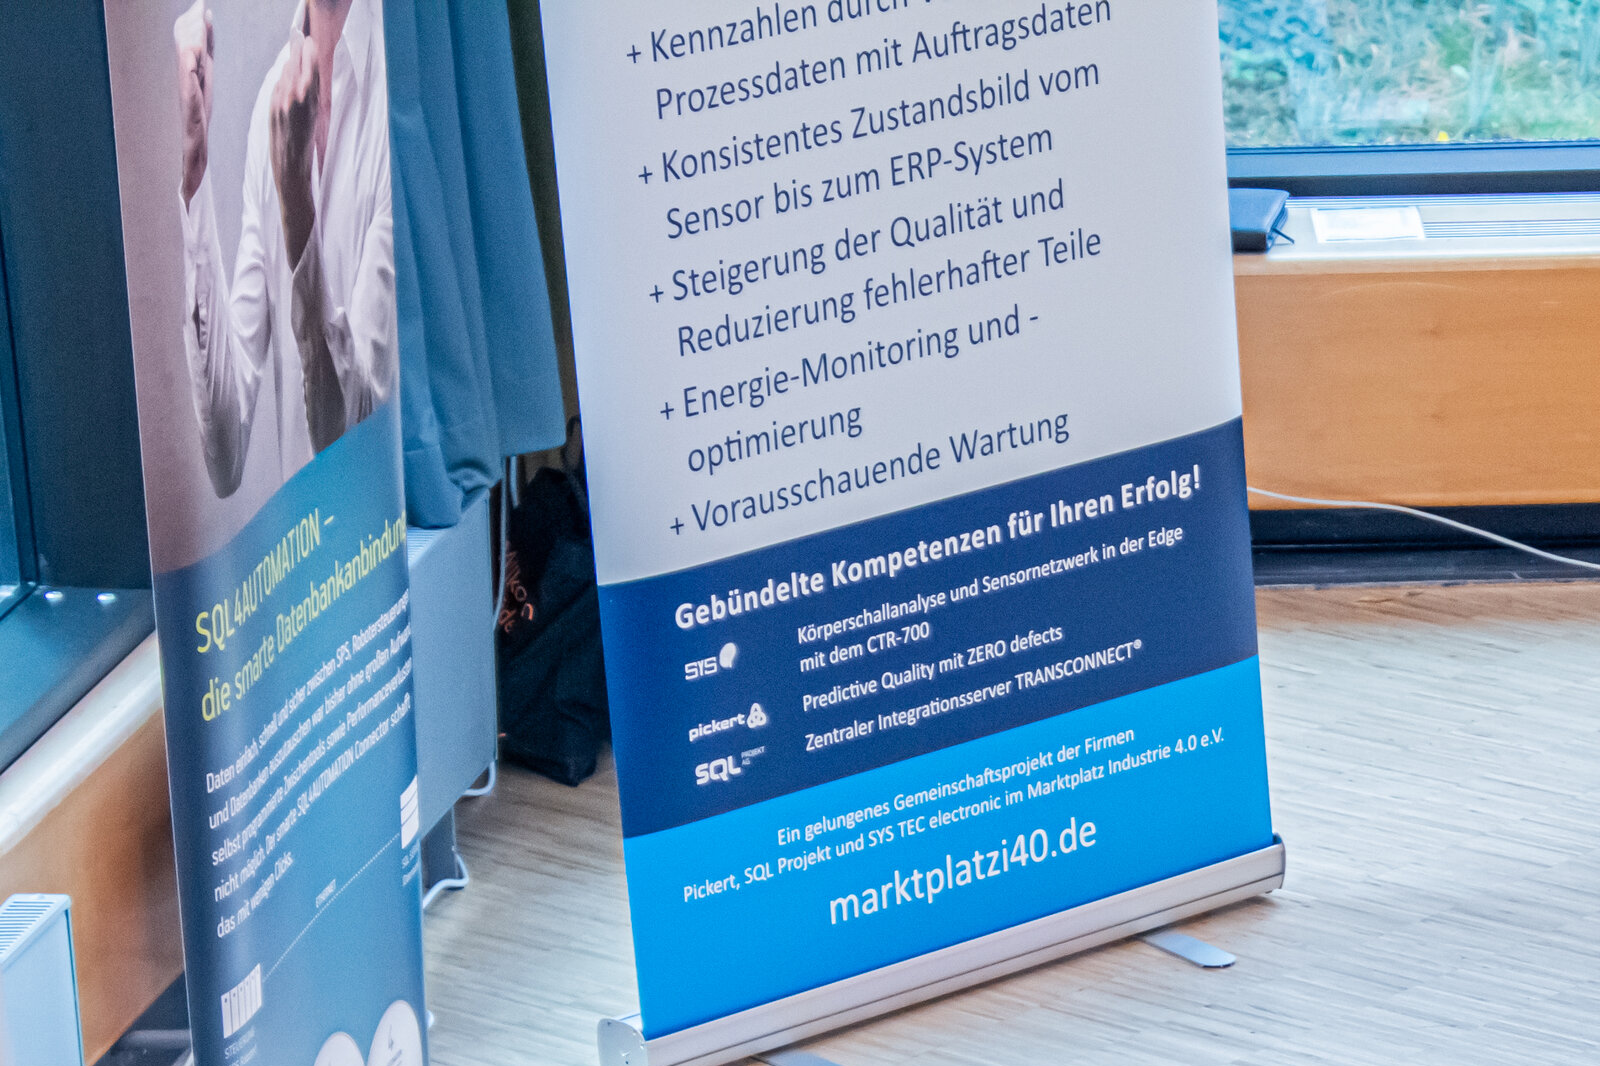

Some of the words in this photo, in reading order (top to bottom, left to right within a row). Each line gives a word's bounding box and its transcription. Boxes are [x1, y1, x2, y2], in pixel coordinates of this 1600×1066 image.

[651, 2, 818, 62] Kennzahlen
[656, 55, 846, 119] Prozessdaten
[857, 38, 903, 75] mit
[912, 0, 1111, 63] Auftragsdaten
[662, 120, 843, 182] Konsistentes
[850, 69, 1030, 139] Zustandsbild
[1039, 62, 1100, 95] vom
[667, 195, 764, 239] Sensor
[773, 179, 813, 214] bis
[821, 168, 880, 203] zum
[890, 129, 1053, 186] ERP-System
[672, 243, 826, 301] Steigerung
[835, 227, 881, 261] der
[890, 196, 1004, 248] Qualität
[1012, 177, 1065, 219] und
[678, 292, 856, 357] Reduzierung
[863, 249, 1031, 310] fehlerhafter
[1037, 228, 1101, 267] Teile
[683, 327, 960, 417] Energie-Monitoring
[968, 303, 1020, 345] und
[688, 407, 863, 476] optimierung
[691, 442, 941, 531] Vorausschauende
[949, 413, 1070, 463] Wartung
[675, 571, 824, 629] Gebündelte
[831, 523, 1001, 588] Kompetenzen
[1007, 509, 1044, 540] für
[1050, 493, 1114, 528] Ihren
[1121, 464, 1201, 509] Erfolg!
[797, 591, 946, 644] Körperschallanalyse
[950, 579, 979, 602] und
[982, 546, 1099, 593] Sensornetzwerk
[1102, 543, 1117, 561] in
[1119, 536, 1145, 556] der
[1147, 526, 1184, 547] Edge
[202, 676, 232, 722] die
[234, 633, 275, 701] smarte
[684, 656, 718, 681] SYS
[800, 652, 826, 673] mit
[829, 642, 864, 665] dem
[867, 621, 930, 654] CTR-700
[802, 679, 878, 712] Predictive
[881, 663, 935, 690] Quality
[938, 652, 965, 674] mit
[967, 639, 1007, 666] ZERO
[1010, 626, 1064, 653] defects
[206, 764, 236, 794] Daten
[277, 698, 289, 727] und
[306, 658, 336, 697] zwischen
[208, 801, 230, 830] und
[311, 704, 324, 727] war
[324, 684, 346, 715] bisher
[346, 669, 365, 696] ohne
[365, 648, 390, 684] großen
[688, 713, 746, 742] pickert
[695, 755, 742, 785] SQL
[805, 720, 875, 752] Zentraler
[878, 680, 1012, 731] Integrationsserver
[211, 832, 242, 867] selbst
[326, 719, 347, 750] sowie
[214, 871, 240, 903] nicht
[276, 807, 297, 842] smarte
[354, 717, 390, 761] Connector
[683, 874, 741, 903] Pickert,
[743, 862, 775, 885] SQL
[777, 845, 832, 874] Projekt
[836, 833, 865, 858] und
[868, 825, 895, 848] SYS
[897, 815, 926, 838] TEC
[929, 794, 1002, 830] electronic
[1004, 789, 1024, 807] im
[1027, 764, 1105, 799] Marktplatz
[1108, 743, 1172, 775] Industrie
[1174, 734, 1198, 754] 4.0
[1200, 727, 1225, 748] e.V.
[777, 827, 801, 846] Ein
[804, 802, 890, 842] gelungenes
[893, 751, 1053, 812] Gemeinschaftsprojekt
[1057, 743, 1081, 764] der
[1084, 728, 1135, 755] Firmen
[217, 916, 236, 939] das
[237, 899, 251, 925] mit
[829, 817, 1098, 925] marktplatzi40.de
